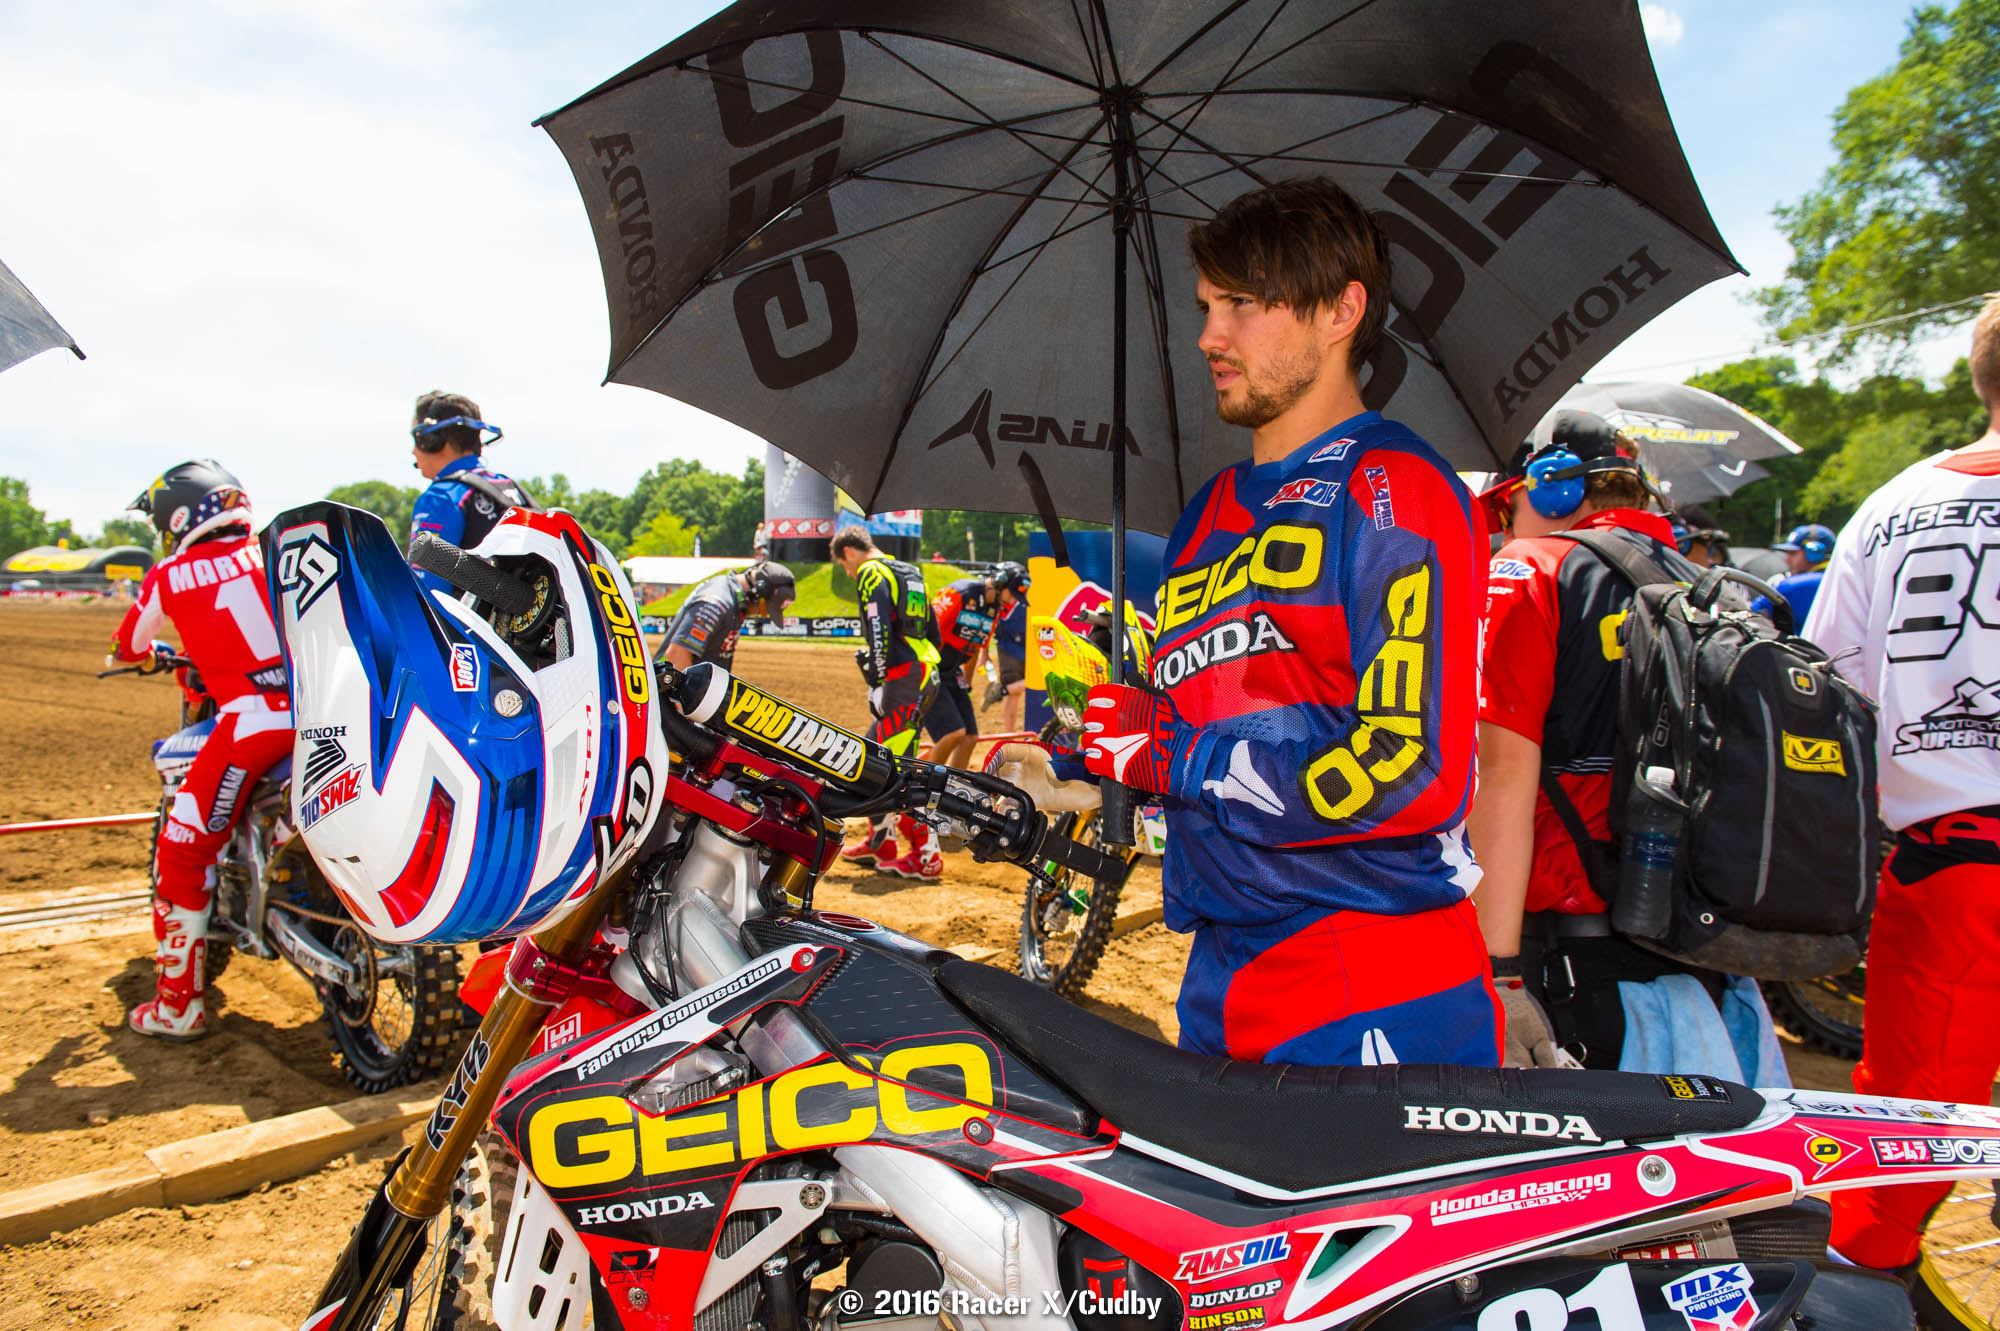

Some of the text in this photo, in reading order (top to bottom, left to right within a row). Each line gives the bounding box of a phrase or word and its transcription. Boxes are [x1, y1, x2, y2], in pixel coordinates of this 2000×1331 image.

[1380, 501, 1394, 528] PRO
[214, 573, 282, 662] 1
[589, 562, 649, 704] GEICO
[812, 618, 861, 629] GoPro
[455, 647, 475, 687] 100%
[1306, 565, 1430, 821] GEICO
[300, 725, 348, 740] HONDA
[1893, 721, 2000, 756] SUPERST
[212, 765, 248, 816] YAMAHA
[301, 768, 362, 829] AMSOIL
[575, 1022, 662, 1082] Factory
[660, 957, 782, 1030] Connection
[528, 1042, 994, 1189] GEICO
[1404, 1106, 1600, 1142] HONDA
[577, 1191, 715, 1226] HONDA
[1430, 1172, 1611, 1216] Honda Racing
[1176, 1234, 1289, 1276] AMSOIL
[1190, 1280, 1282, 1308] DUNLOP
[1670, 1265, 1744, 1302] MX
[1688, 1290, 1742, 1313] PRO RACING
[1691, 1286, 1733, 1302] SPORTS
[1189, 1307, 1264, 1330] HINSON
